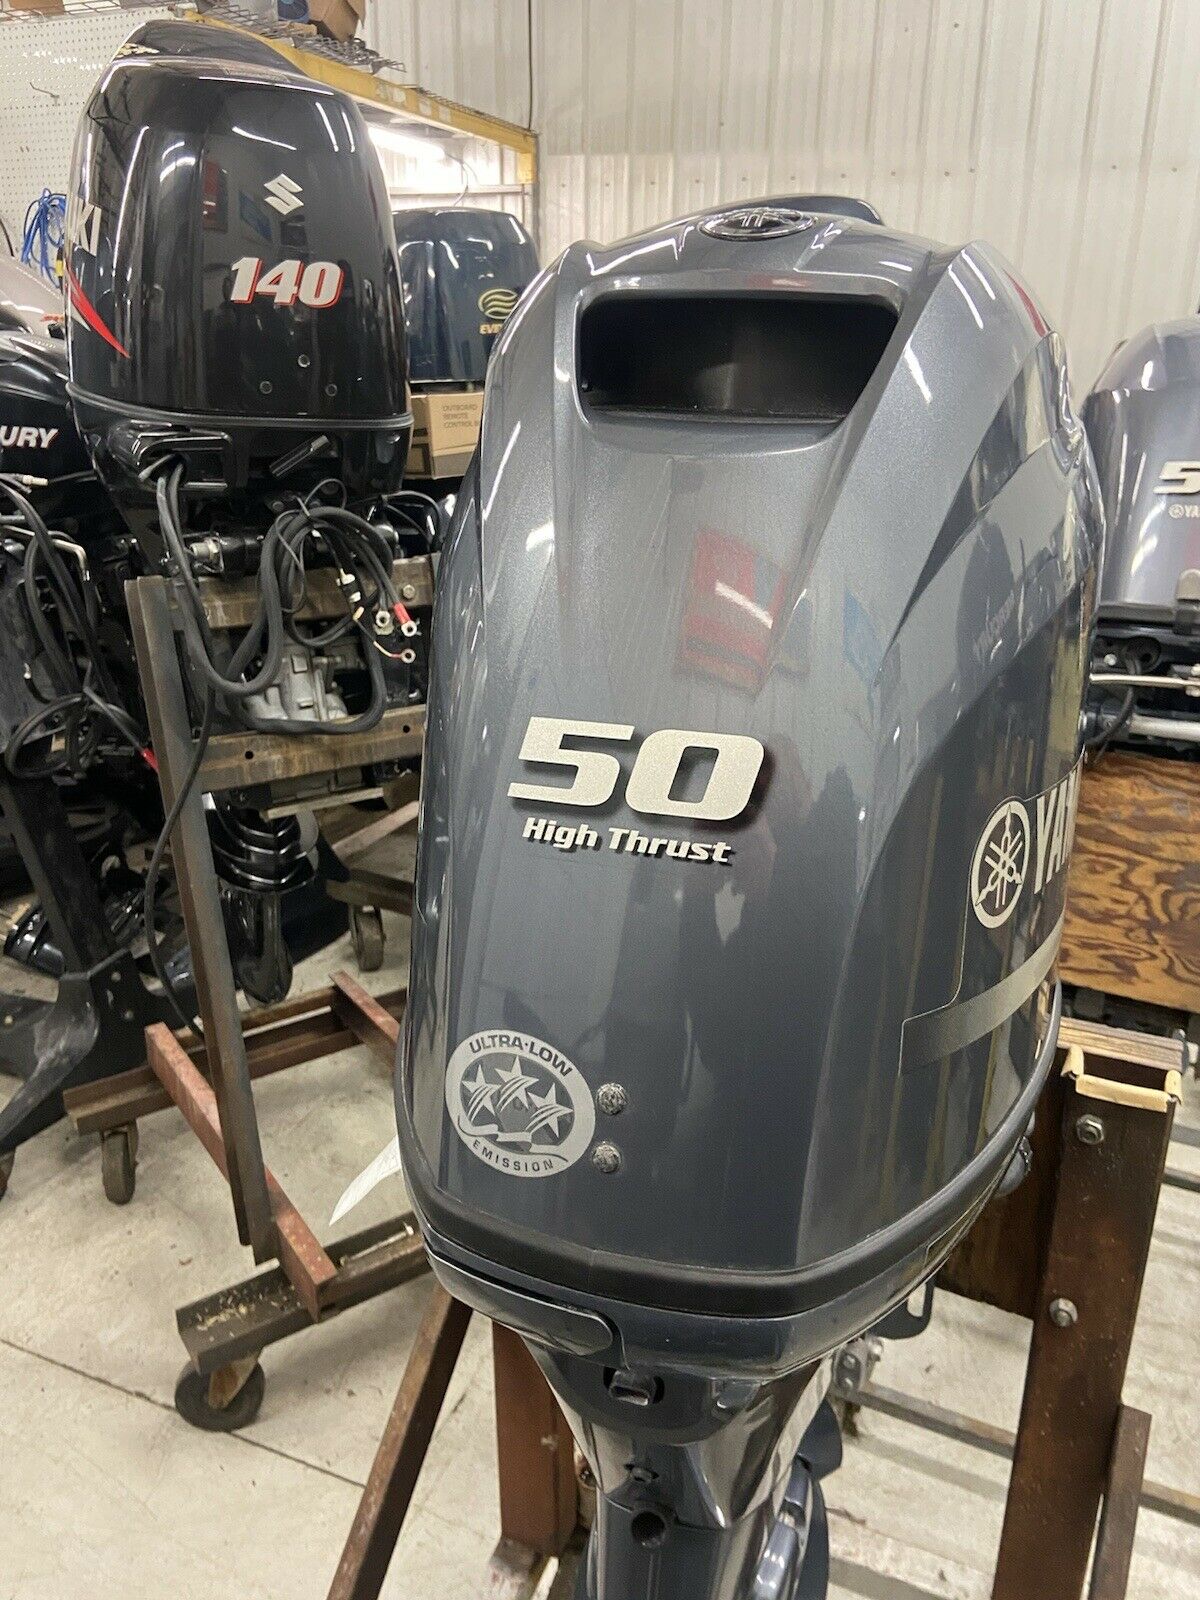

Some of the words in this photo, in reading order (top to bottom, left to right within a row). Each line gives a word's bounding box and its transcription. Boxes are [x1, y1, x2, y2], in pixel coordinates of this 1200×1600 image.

[230, 257, 345, 308] 140
[507, 716, 765, 821] 50
[522, 816, 599, 850] High
[608, 827, 732, 864] Thrust
[472, 1138, 554, 1173] EMISSION
